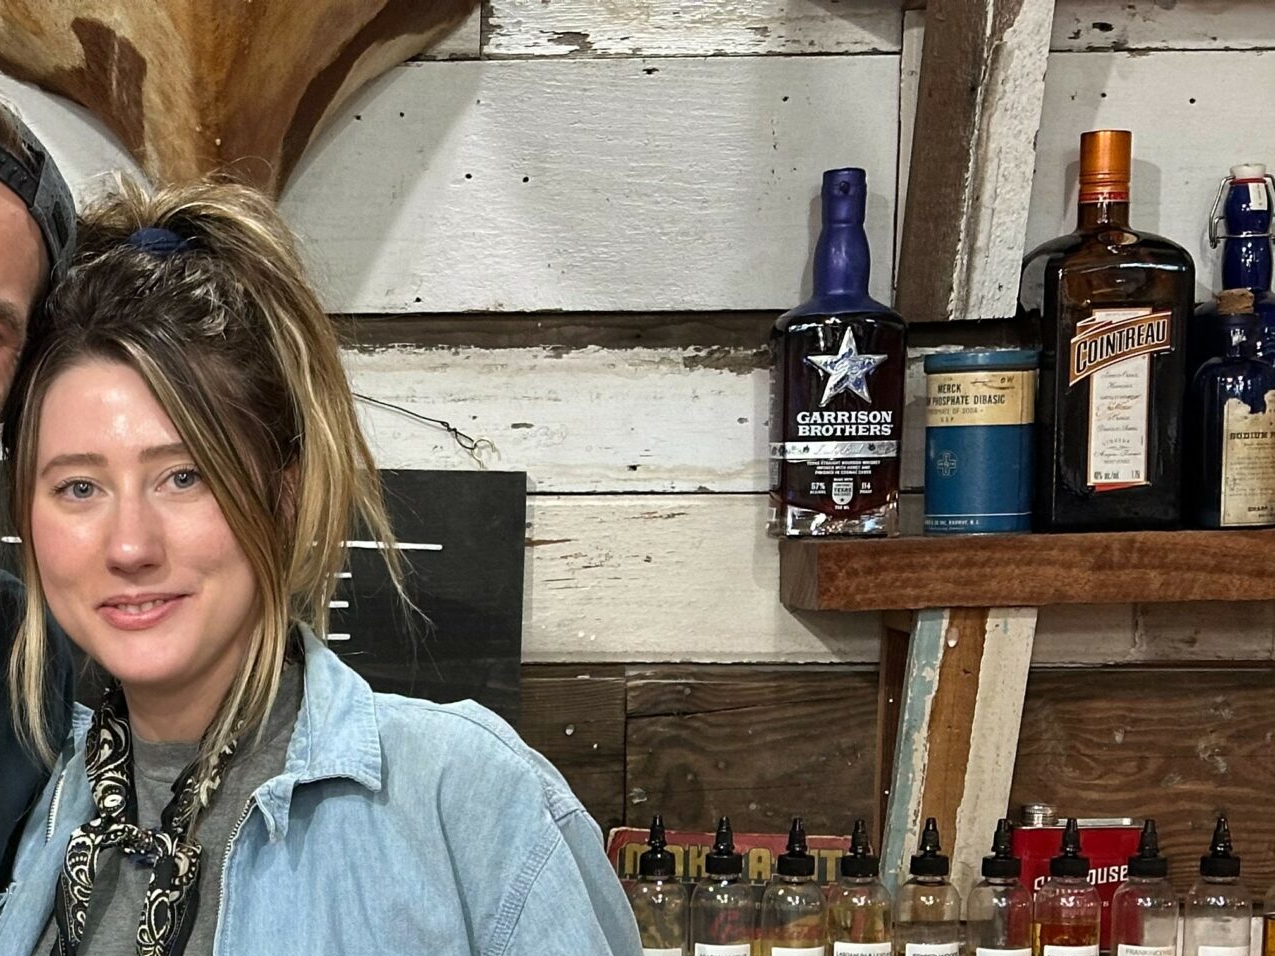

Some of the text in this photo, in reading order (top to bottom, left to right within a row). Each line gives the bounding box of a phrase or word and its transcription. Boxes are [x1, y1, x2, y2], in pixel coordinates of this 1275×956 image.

[1075, 319, 1168, 375] COINTREAU
[937, 383, 961, 394] MERCK
[932, 394, 1006, 406] PHOSPHATE DIBASIC
[796, 411, 893, 423] GARRISON
[797, 424, 893, 437] BROTHERS
